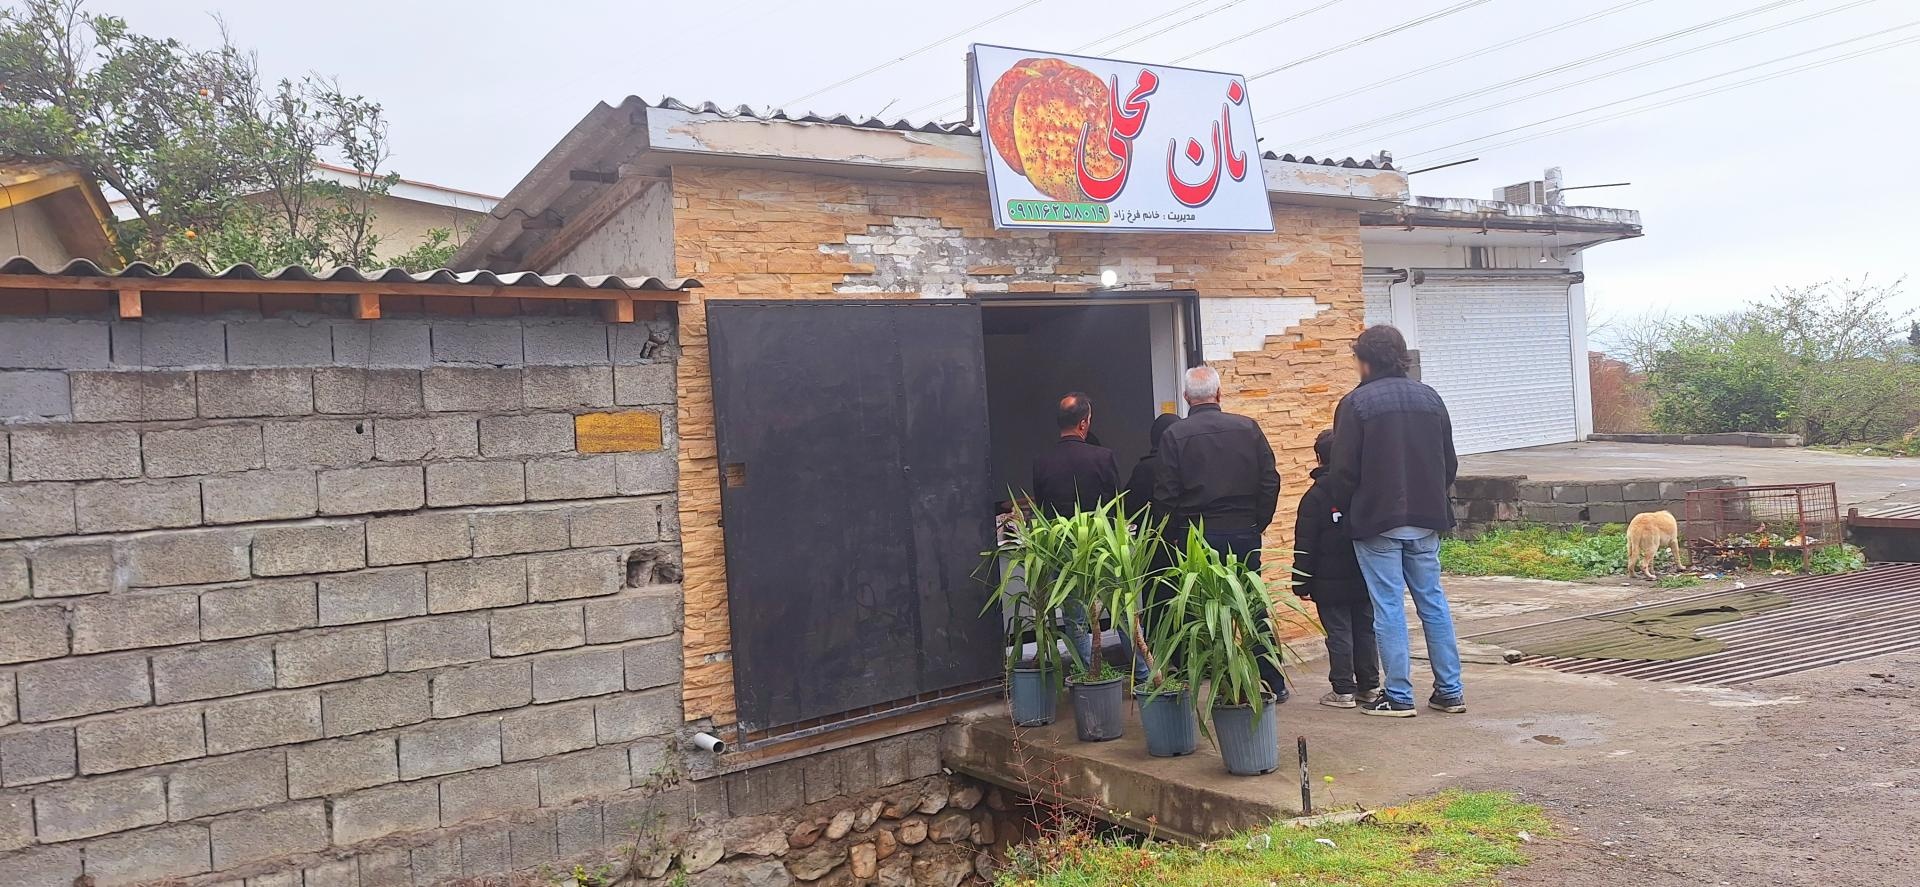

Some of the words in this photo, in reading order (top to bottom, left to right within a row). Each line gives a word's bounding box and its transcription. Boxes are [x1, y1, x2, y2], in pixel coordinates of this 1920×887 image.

[1076, 69, 1159, 202] محلی
[1167, 79, 1246, 207] نان
[1113, 210, 1125, 221] زاد
[1127, 209, 1141, 224] فرخ
[1143, 209, 1160, 221] خانم
[1167, 211, 1196, 222] مدیریت
